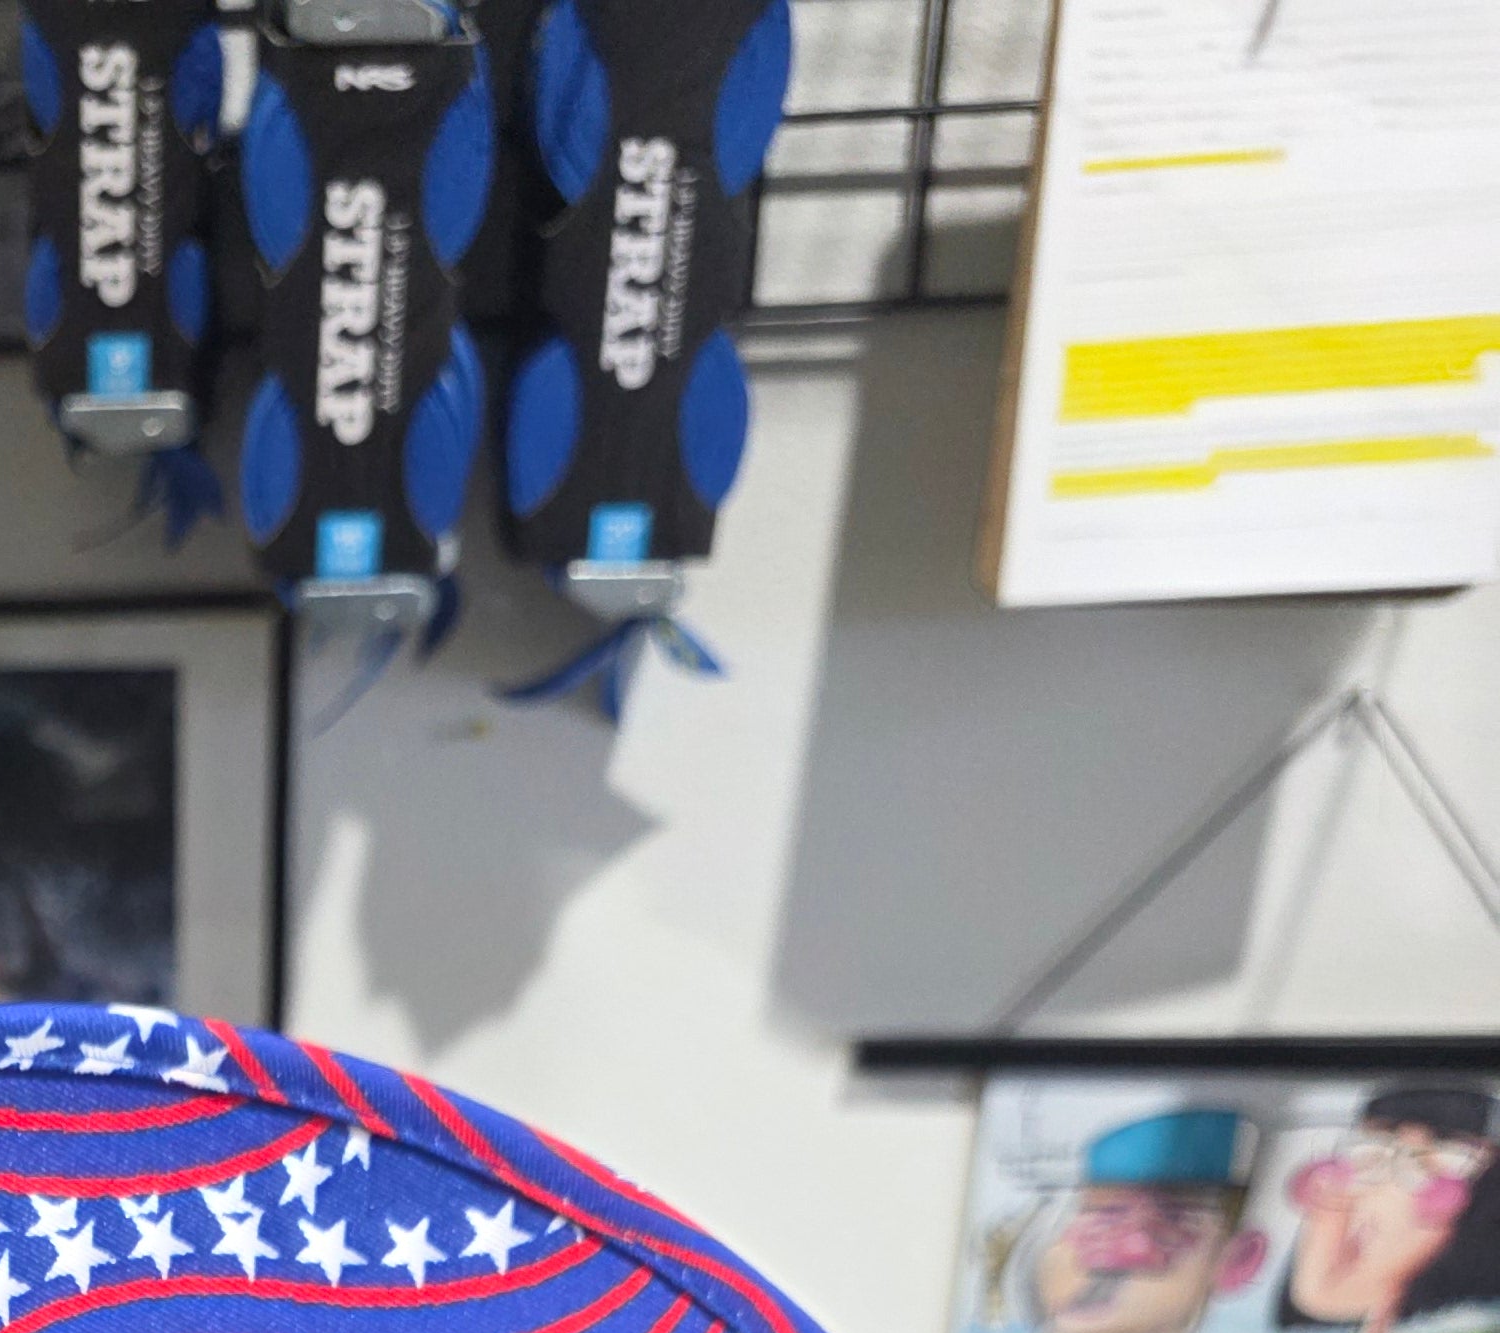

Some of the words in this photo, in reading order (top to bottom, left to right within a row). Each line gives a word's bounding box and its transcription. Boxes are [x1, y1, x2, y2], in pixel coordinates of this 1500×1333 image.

[78, 42, 138, 307] STRAP
[599, 137, 675, 389] STRAP
[315, 180, 385, 445] STRAP
